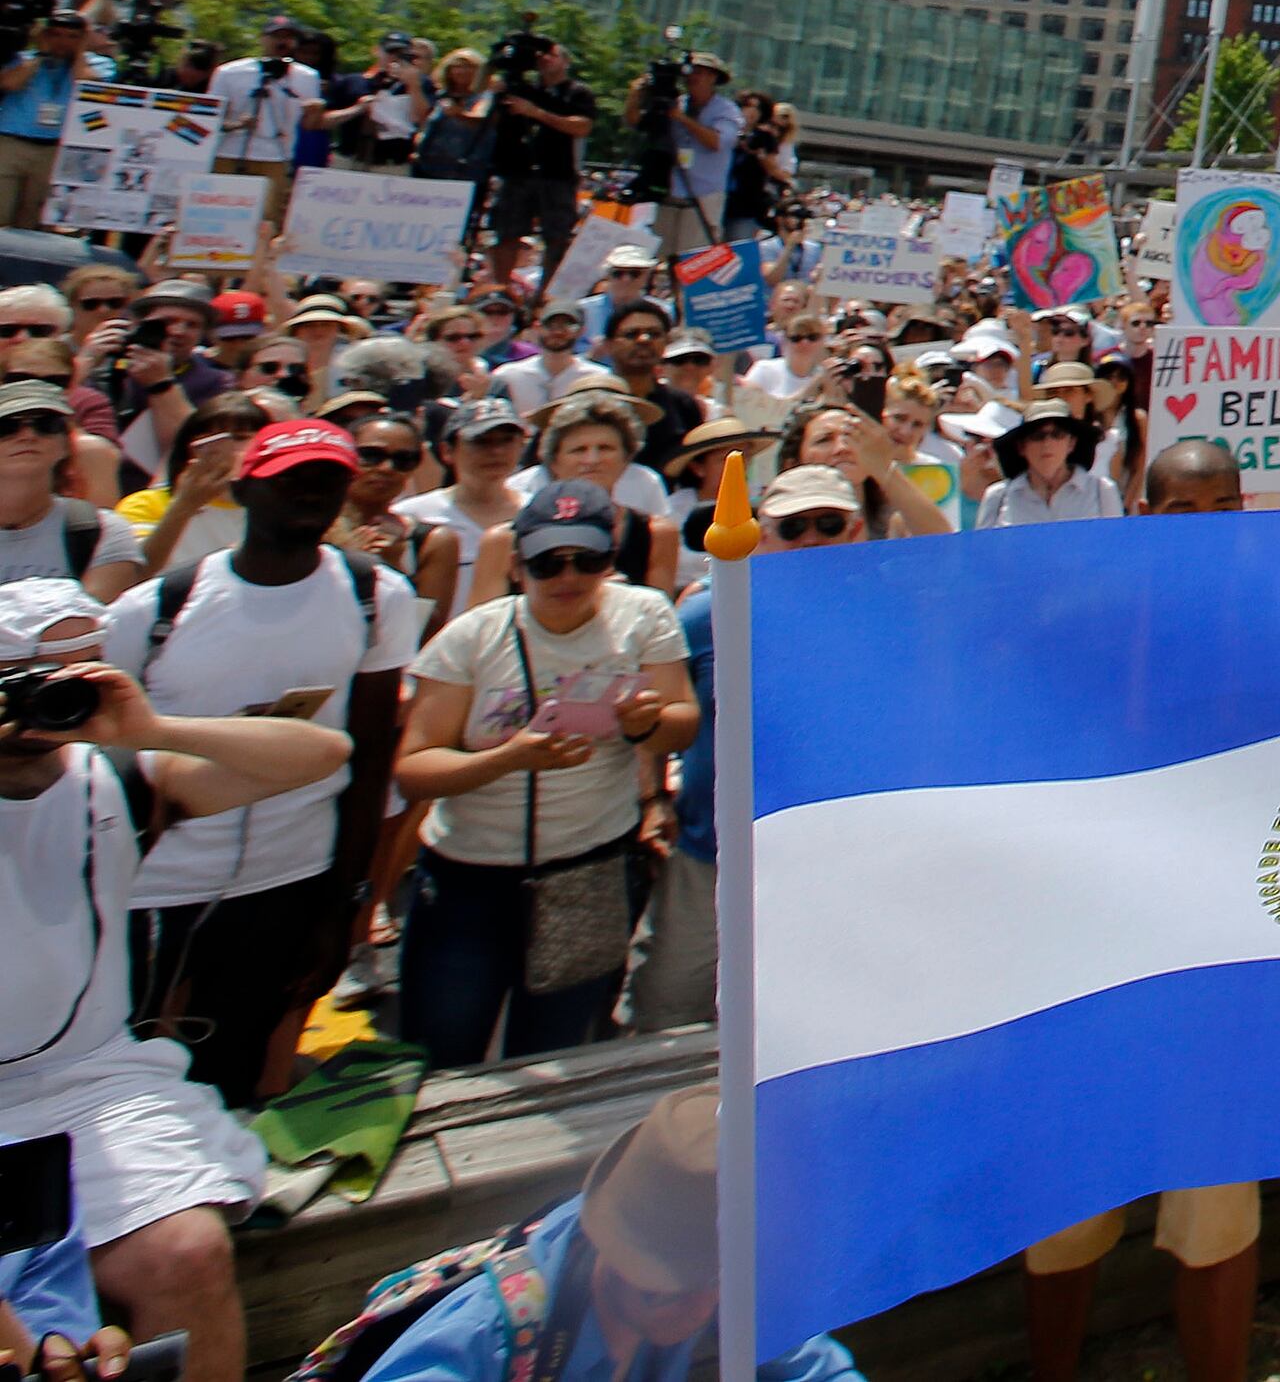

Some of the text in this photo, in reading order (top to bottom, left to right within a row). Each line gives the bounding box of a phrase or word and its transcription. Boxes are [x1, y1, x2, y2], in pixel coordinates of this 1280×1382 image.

[997, 177, 1106, 232] WE CARE
[320, 217, 459, 255] GENOCIDE
